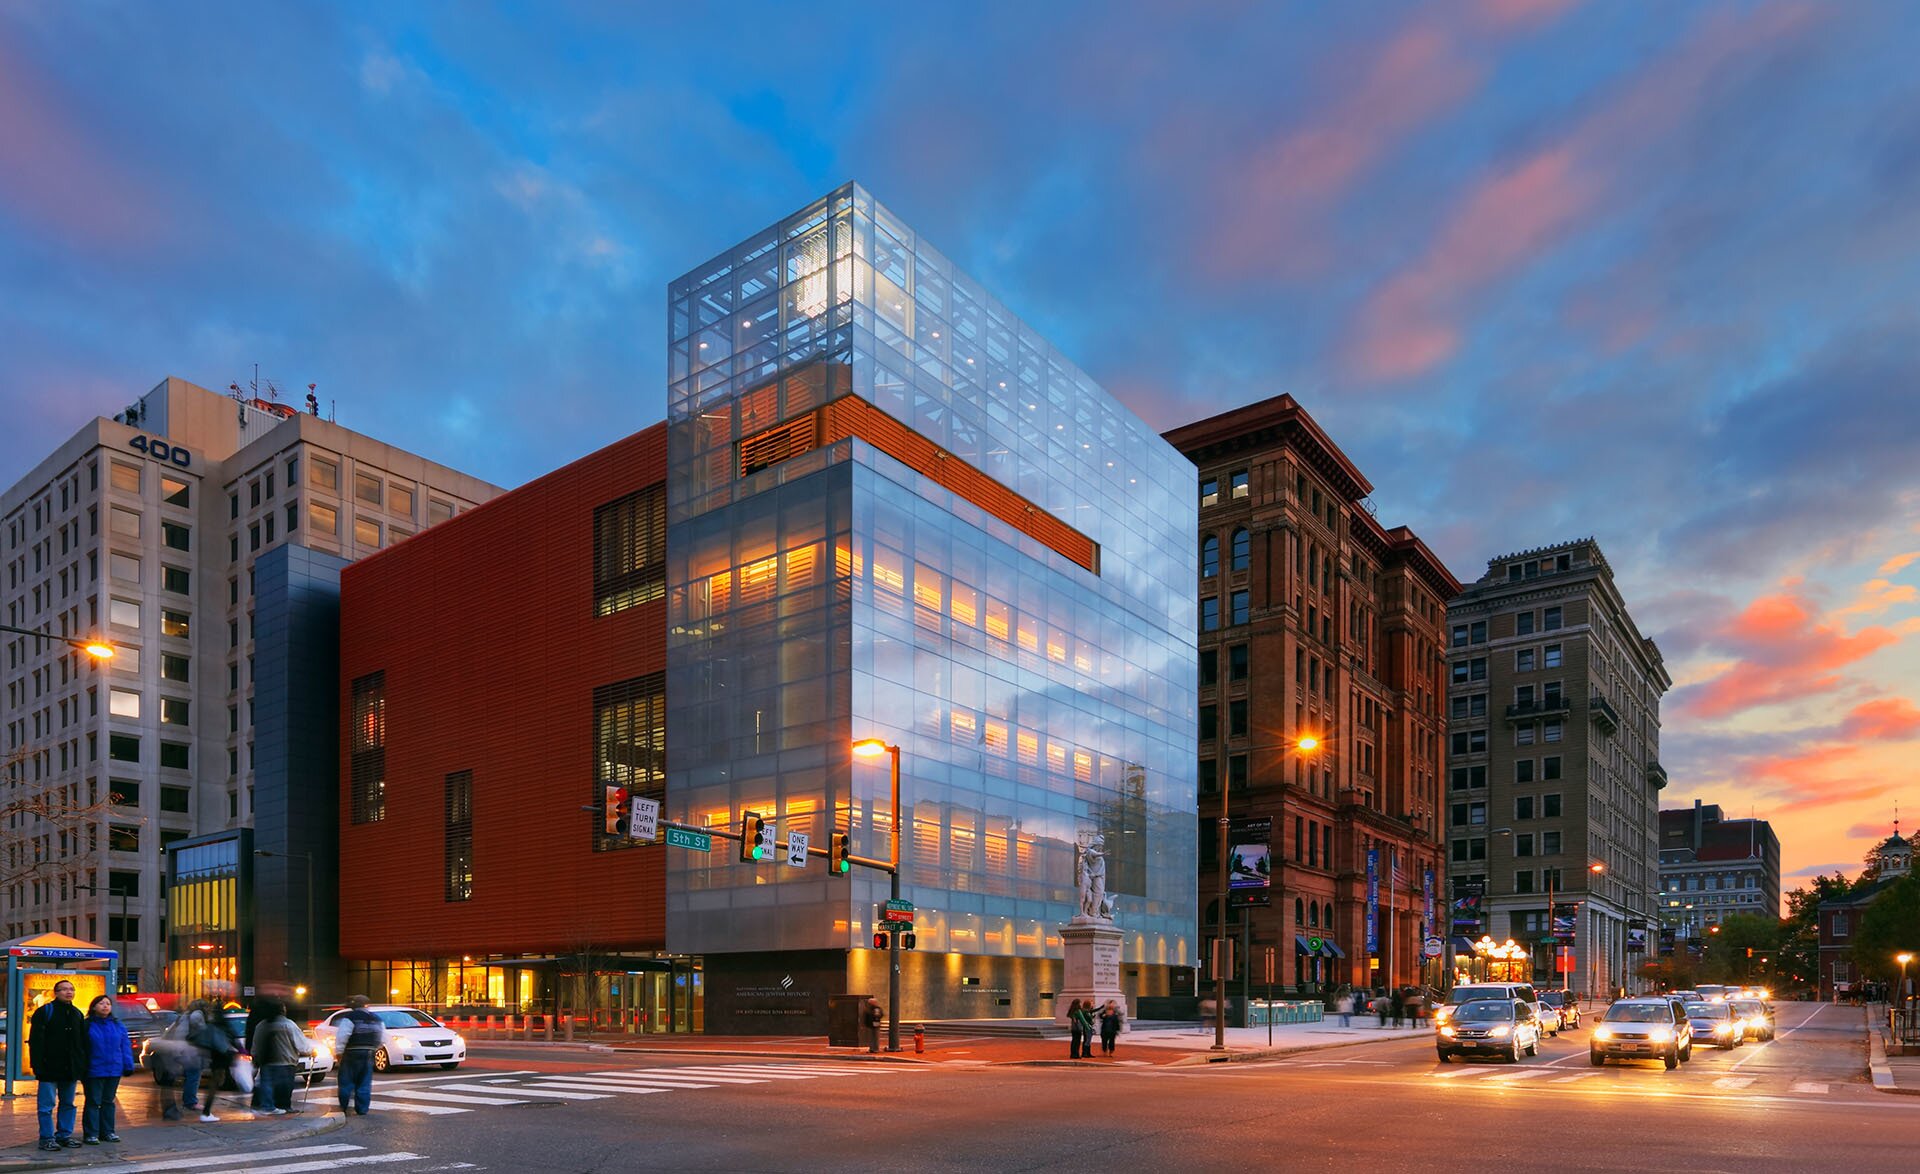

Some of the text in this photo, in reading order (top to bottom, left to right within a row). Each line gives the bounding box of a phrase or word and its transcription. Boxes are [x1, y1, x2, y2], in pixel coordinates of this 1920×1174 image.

[129, 435, 190, 467] 400
[636, 803, 655, 812] LEFT
[635, 813, 654, 823] TURN
[632, 824, 654, 835] SIGNAL
[762, 828, 773, 836] EFT
[673, 832, 706, 847] 5th St
[792, 835, 805, 845] ONE
[791, 845, 805, 854] WAY
